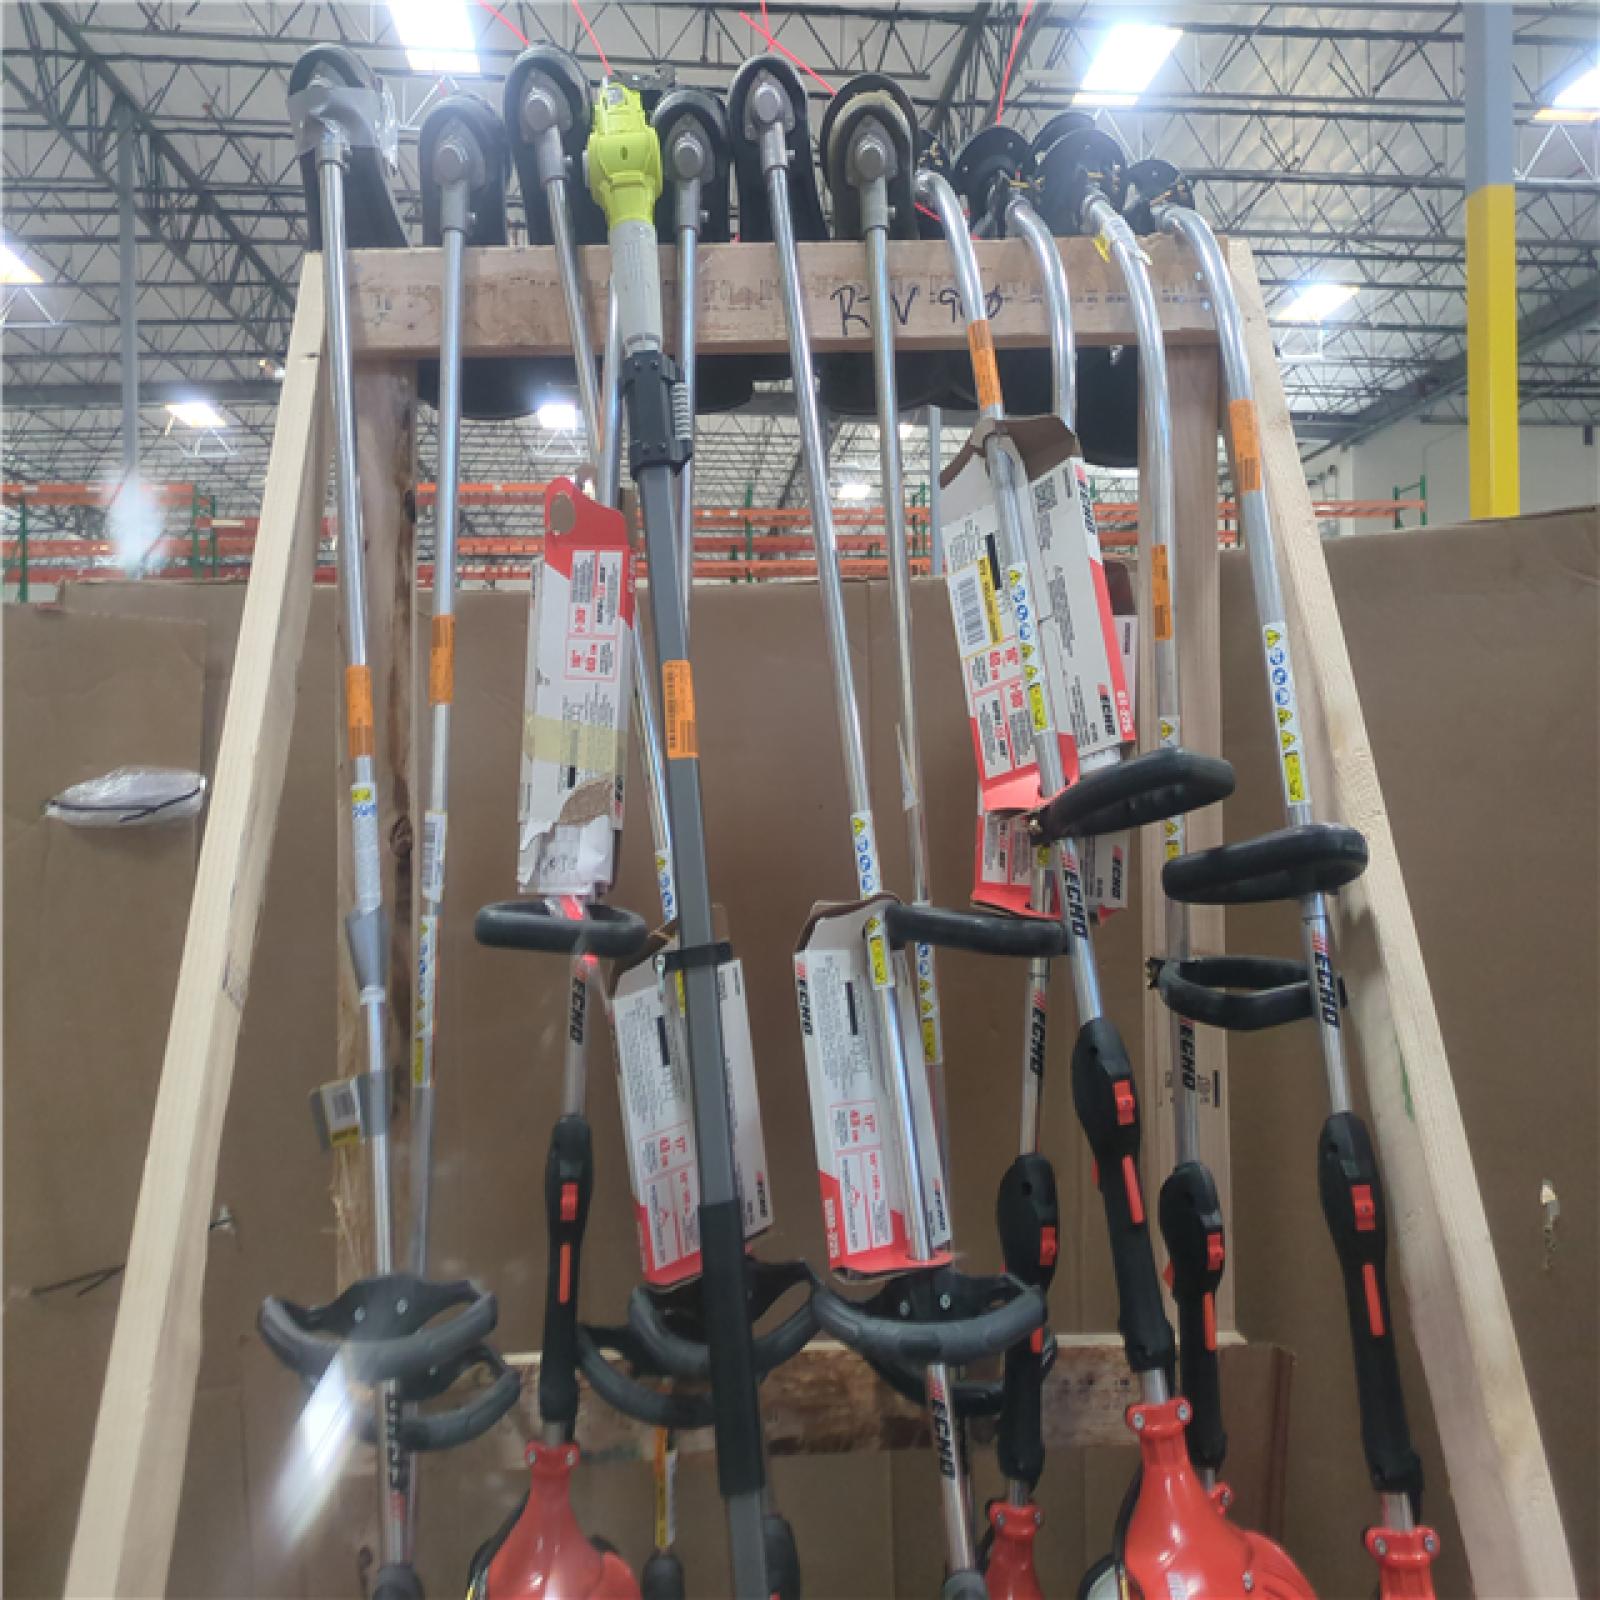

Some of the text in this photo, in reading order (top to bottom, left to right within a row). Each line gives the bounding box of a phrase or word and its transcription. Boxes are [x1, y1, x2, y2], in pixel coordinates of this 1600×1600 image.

[1100, 693, 1116, 735] ECHO
[1064, 869, 1088, 940] ECHO
[569, 976, 586, 1045] ECHO
[799, 979, 813, 1036] ECHO
[1315, 953, 1341, 1028] ECHO
[1029, 1007, 1046, 1077] ECHO
[1180, 1024, 1196, 1091] ECHO
[931, 1398, 956, 1480] ECHO
